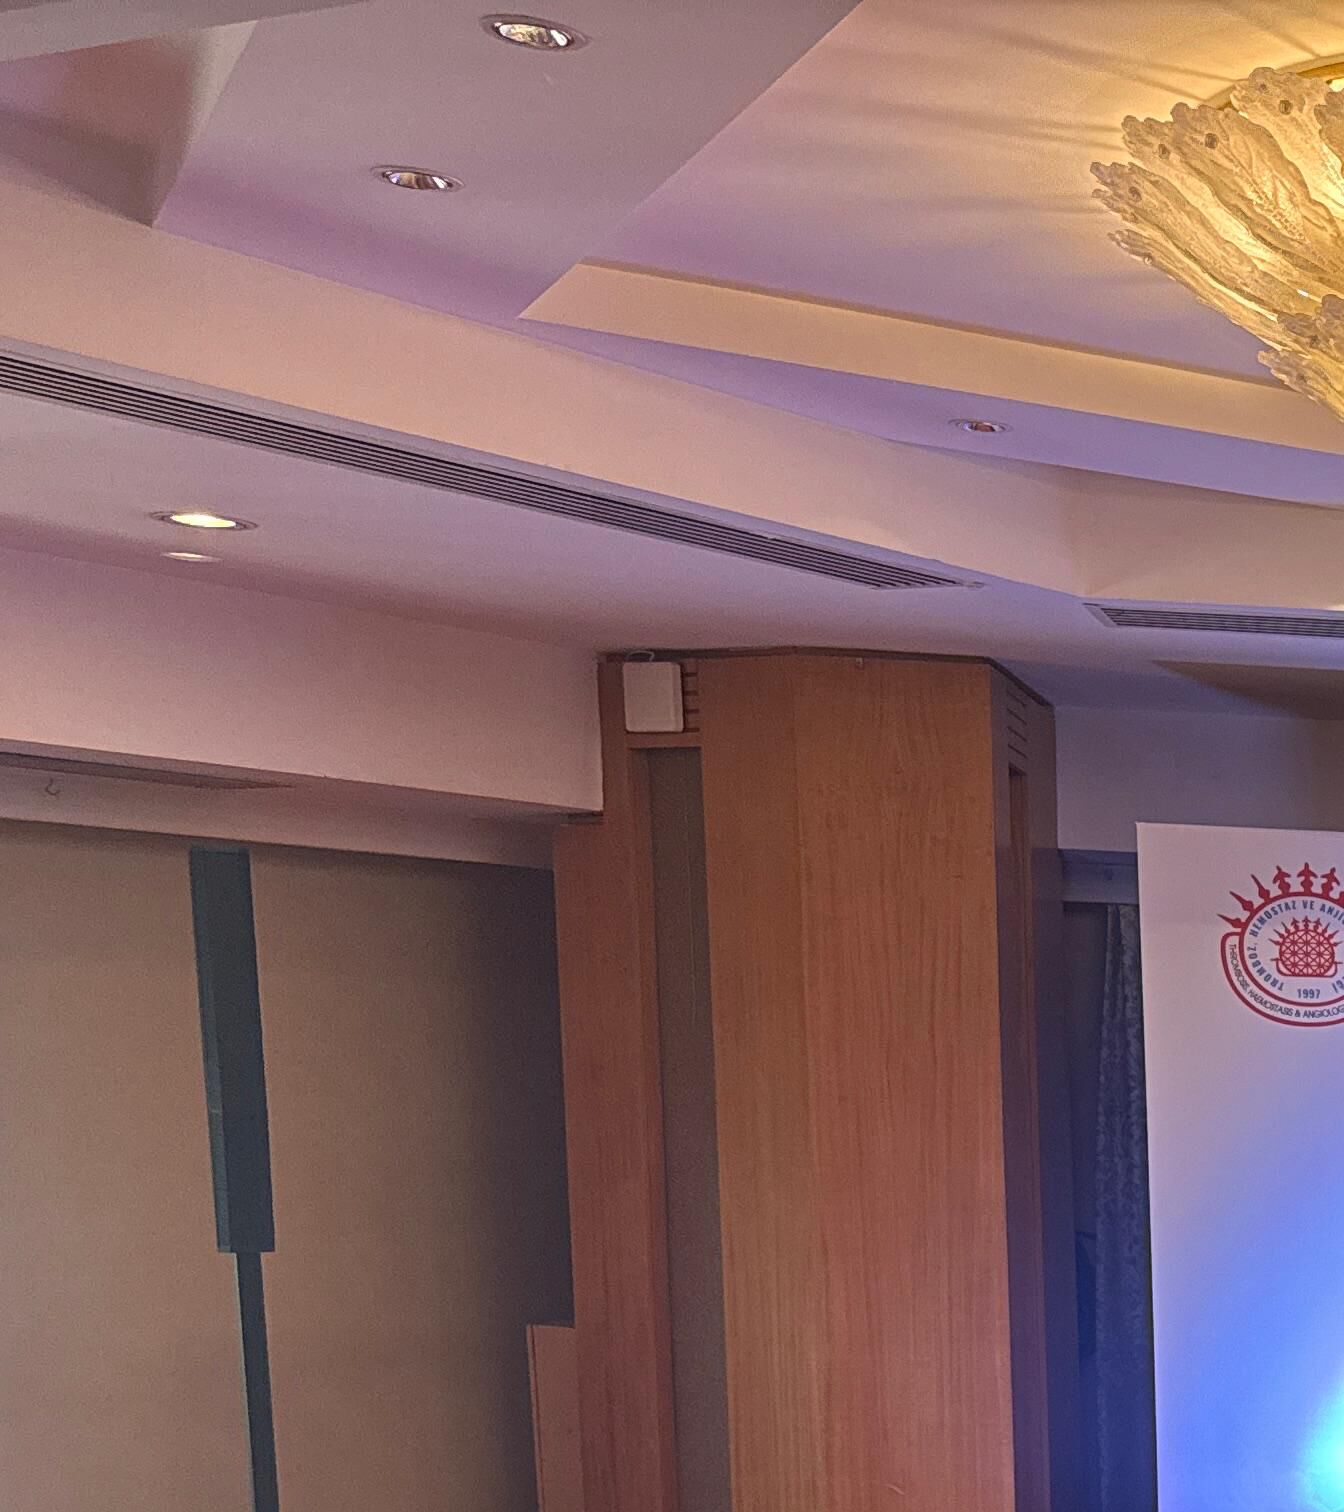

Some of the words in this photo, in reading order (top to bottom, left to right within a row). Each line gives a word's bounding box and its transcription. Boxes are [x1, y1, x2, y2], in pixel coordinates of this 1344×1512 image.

[1249, 901, 1297, 938] HEMOSTAZ
[1302, 900, 1315, 911] VE
[1297, 988, 1321, 999] 1997
